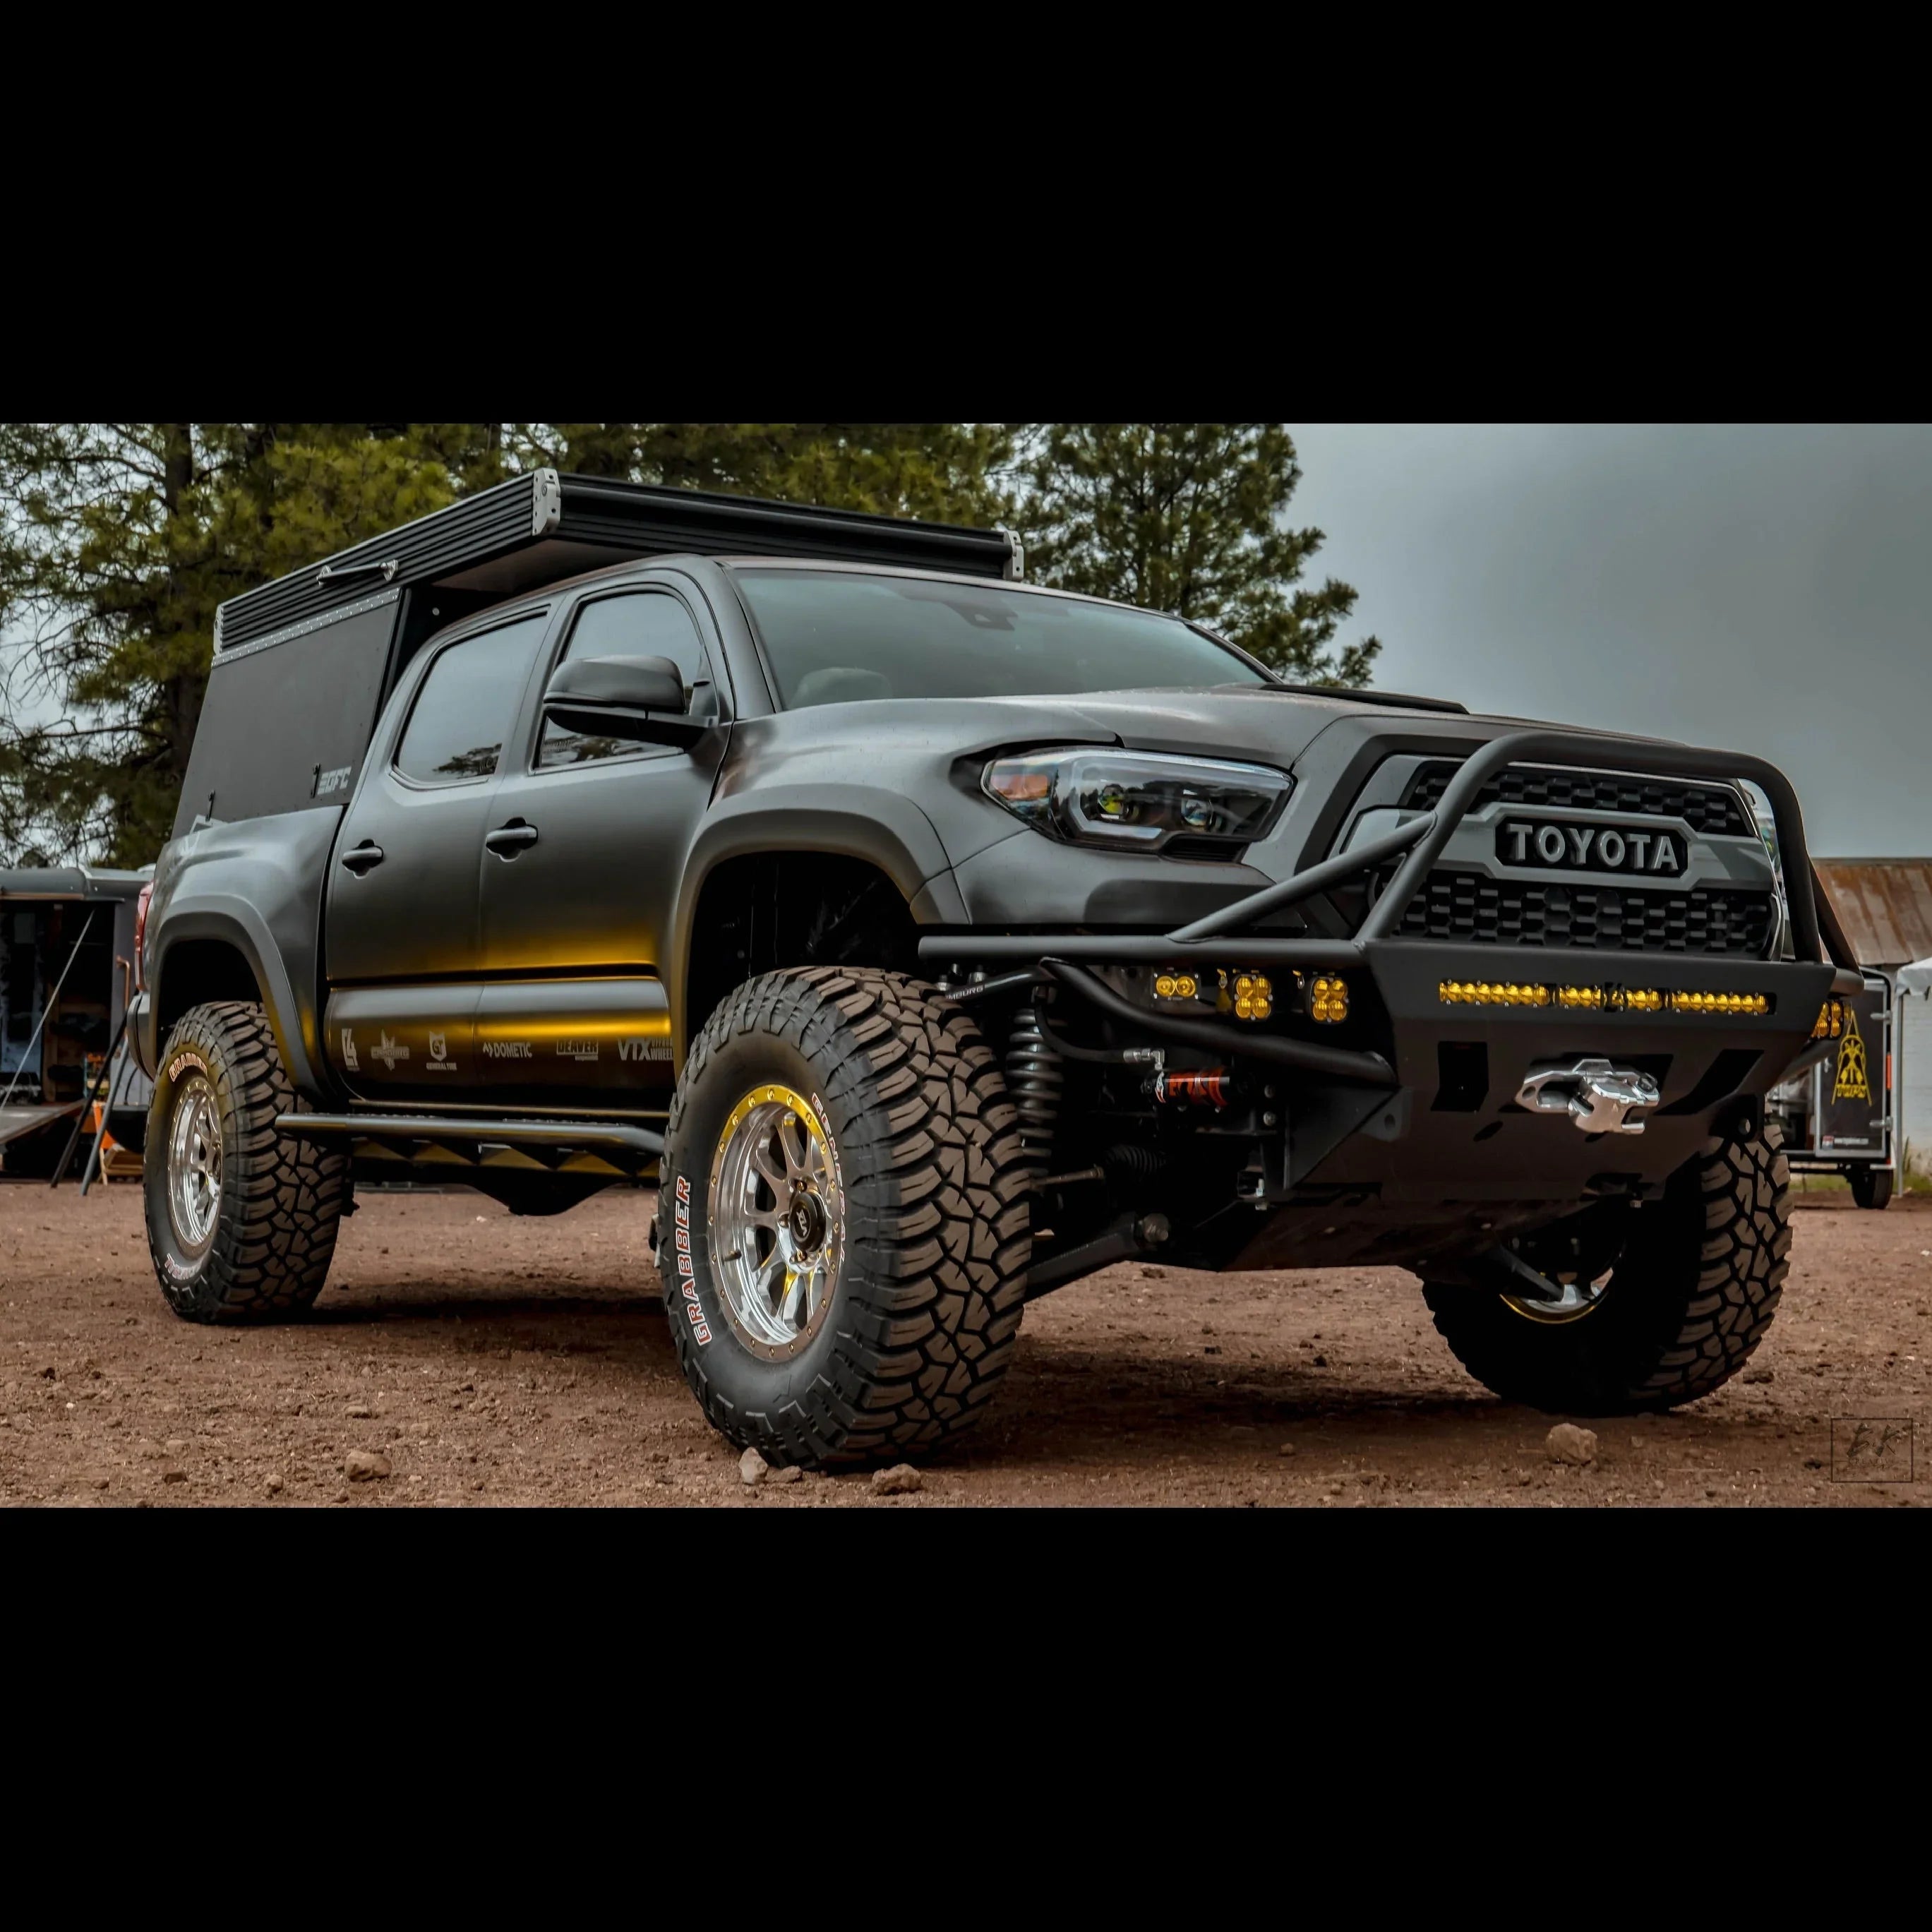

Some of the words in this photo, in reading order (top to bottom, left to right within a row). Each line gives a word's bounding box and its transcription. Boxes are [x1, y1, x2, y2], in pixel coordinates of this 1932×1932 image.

[1506, 822, 1679, 871] TOYOTA
[494, 1041, 533, 1059] DOMETIC
[617, 1037, 652, 1061] VTX
[674, 1175, 714, 1347] GRABBER
